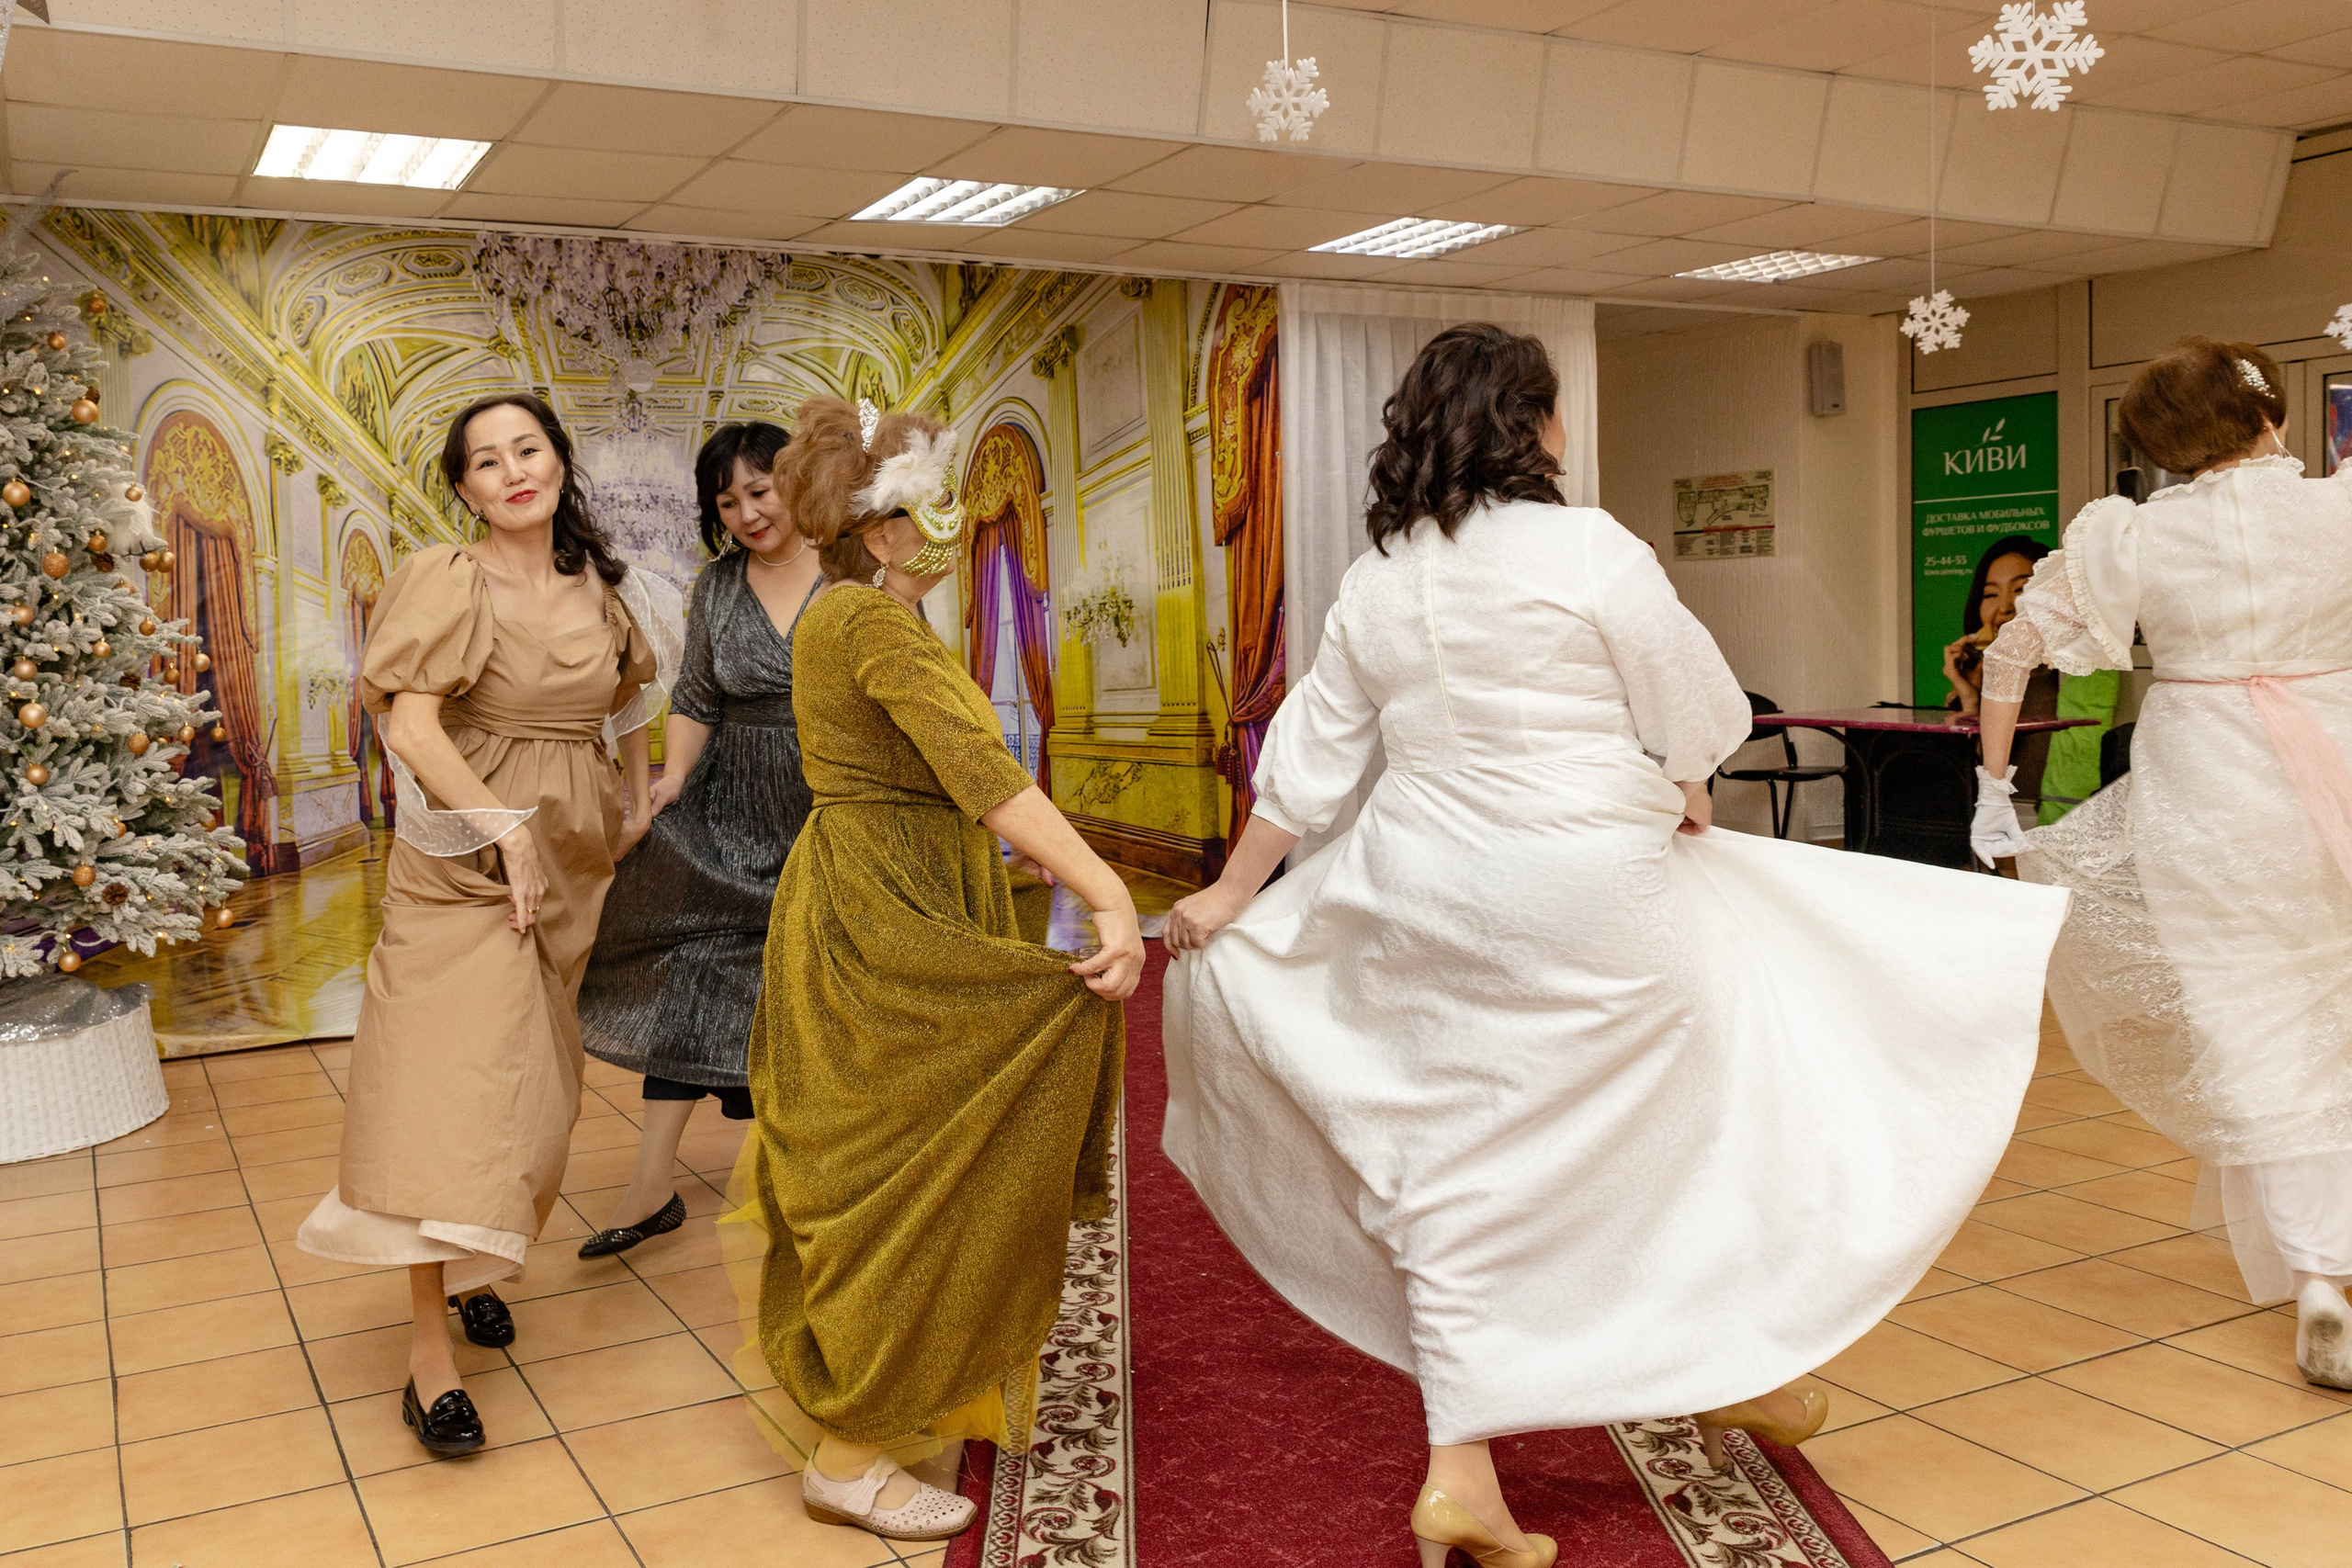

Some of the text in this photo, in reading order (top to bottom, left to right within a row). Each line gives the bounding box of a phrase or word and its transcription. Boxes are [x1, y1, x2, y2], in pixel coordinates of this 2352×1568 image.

[1943, 444, 2027, 476] КИВИ
[1926, 506, 2045, 525] ДОСТАВКА МОБИЛЬНЫХ
[1922, 520, 2050, 536] ФУРШЕТОВ И ФУДБОКСОВ
